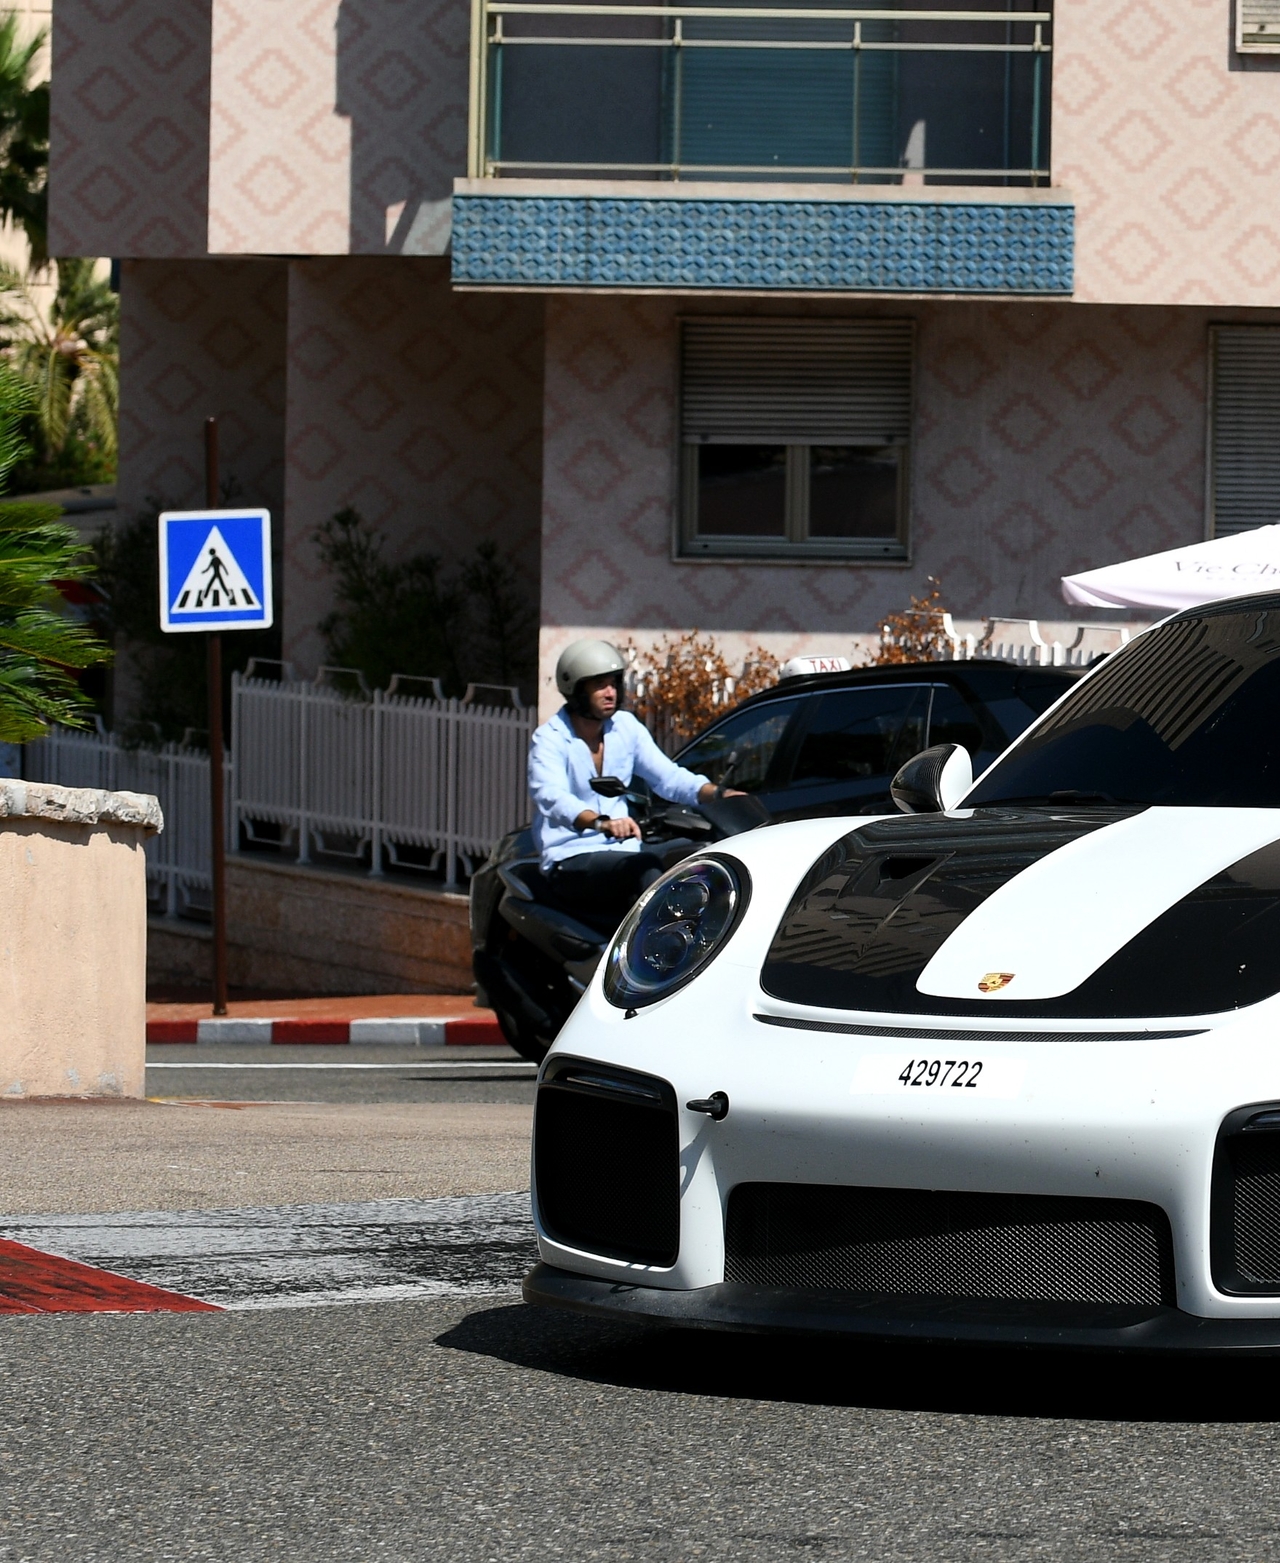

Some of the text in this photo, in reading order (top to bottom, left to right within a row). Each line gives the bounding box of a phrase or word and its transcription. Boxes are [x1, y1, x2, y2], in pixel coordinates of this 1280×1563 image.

[1175, 561, 1222, 573] Vie
[809, 659, 842, 672] TAXI
[898, 1059, 983, 1087] 429722
